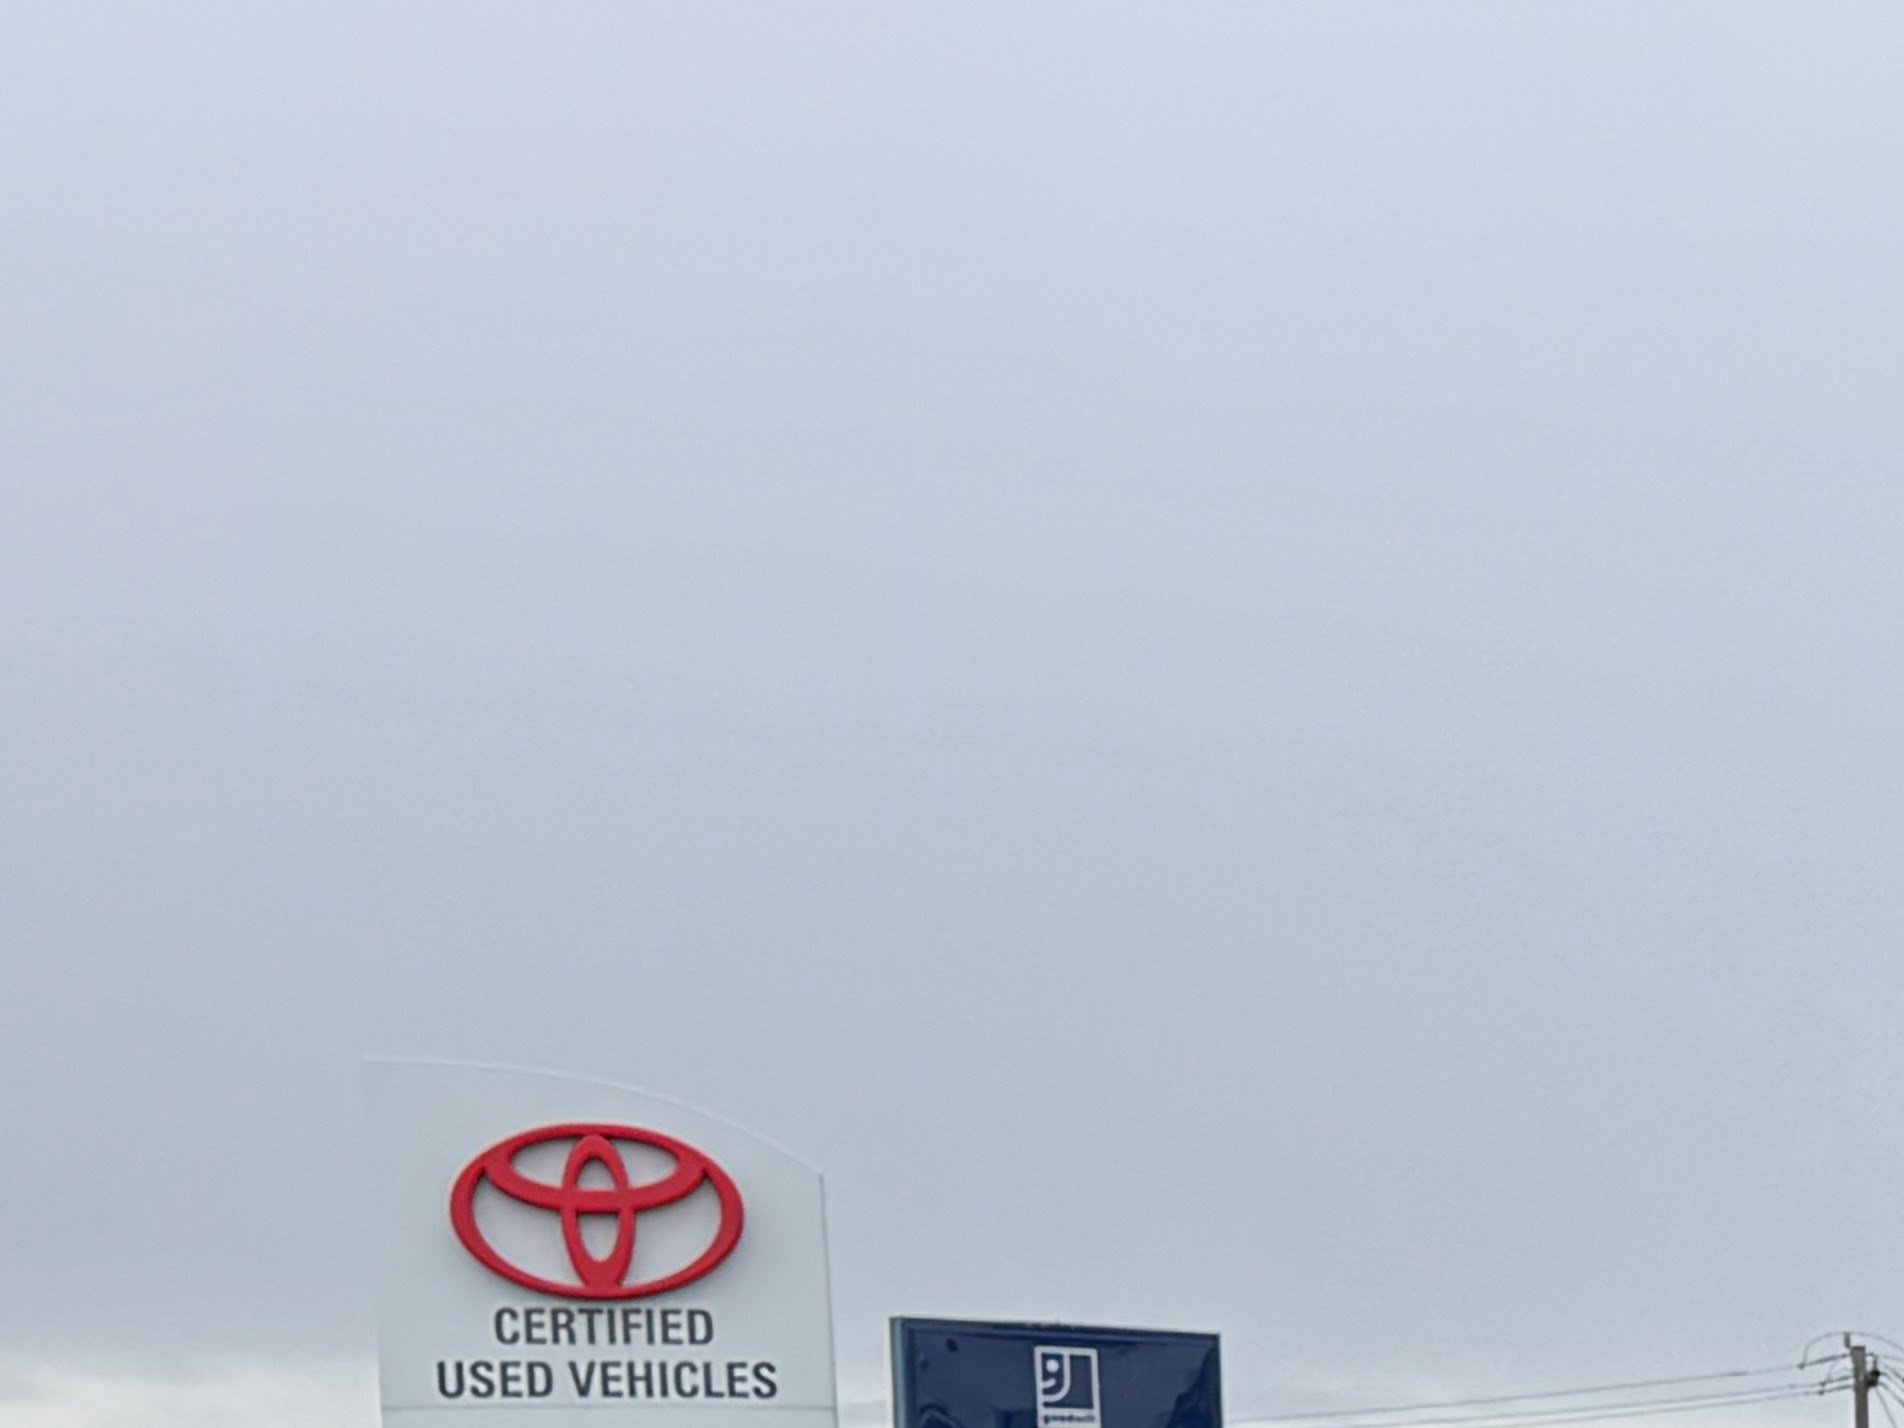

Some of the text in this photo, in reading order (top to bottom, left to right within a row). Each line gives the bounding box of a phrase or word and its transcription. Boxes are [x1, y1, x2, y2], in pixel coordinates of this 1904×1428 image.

[494, 1307, 715, 1346] CERTIFIED
[436, 1360, 778, 1400] USED VEHICLES
[1042, 1412, 1095, 1425] goodwill
